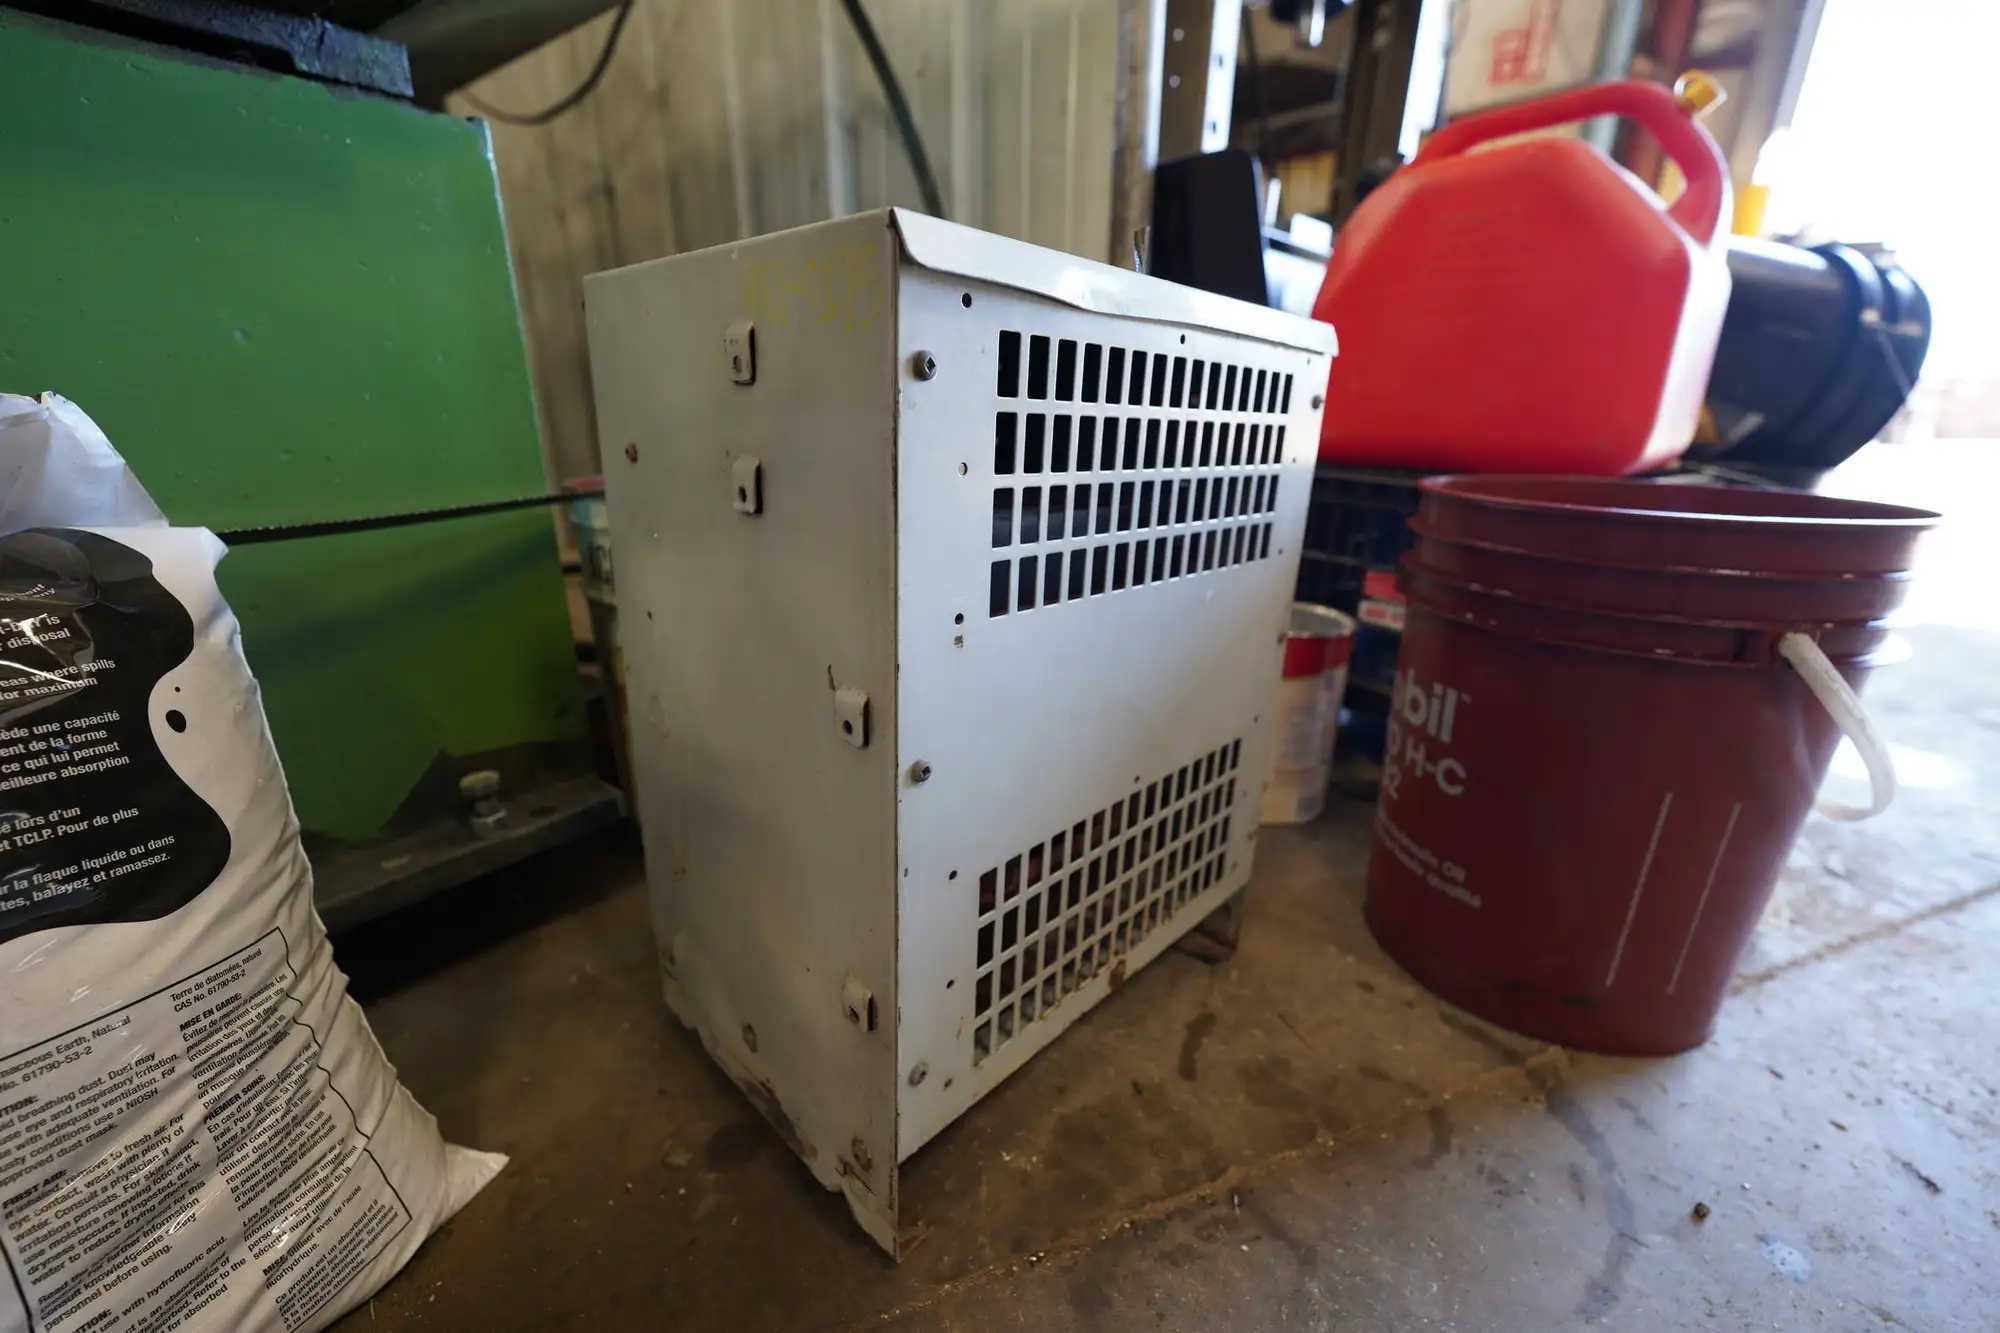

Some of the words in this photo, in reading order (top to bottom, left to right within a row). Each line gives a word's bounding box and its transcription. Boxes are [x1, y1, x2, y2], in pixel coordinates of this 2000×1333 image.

[7, 627, 71, 648] disposal
[46, 616, 60, 626] is
[0, 677, 28, 687] eas
[81, 659, 116, 672] spills
[24, 677, 98, 696] maximum
[0, 727, 29, 741] ède
[32, 722, 61, 735] une
[64, 710, 120, 729] capacité
[0, 744, 26, 758] ent
[28, 739, 48, 750] de
[49, 737, 65, 747] la
[67, 730, 107, 744] forme
[1, 762, 21, 773] ce
[24, 757, 49, 771] qui
[51, 750, 70, 763] lui
[73, 741, 120, 761] permet
[61, 755, 130, 778] absorption
[13, 829, 55, 848] TCLP.
[57, 820, 90, 836] Pour
[93, 814, 110, 827] de
[112, 807, 139, 824] plus
[15, 815, 45, 830] lors
[49, 806, 81, 822] d'un
[0, 896, 30, 912] tes,
[32, 877, 90, 901] balayez
[93, 871, 107, 883] et
[109, 853, 171, 878] ramassez.
[14, 879, 29, 891] la
[32, 863, 79, 886] flaque
[81, 850, 127, 872] liquide
[129, 845, 145, 857] ou
[147, 835, 175, 850] dans
[170, 988, 193, 1002] Terre
[194, 981, 205, 991] de
[205, 962, 242, 984] diatomées,
[174, 998, 192, 1013] CAS
[193, 993, 207, 1004] No.
[207, 969, 247, 997] 61790-53-2
[179, 1014, 201, 1032] MISE
[202, 1007, 215, 1019] EN
[215, 992, 242, 1012] GARDE:
[0, 1050, 53, 1078] maceous
[55, 1035, 90, 1055] Earth,
[91, 1016, 131, 1039] Natural
[182, 1024, 208, 1042] Évitez
[22, 1046, 93, 1083] 61790-53-2
[18, 1091, 76, 1122] breathing
[78, 1077, 106, 1096] dust.
[108, 1063, 132, 1080] Dust
[134, 1052, 156, 1068] may
[25, 1118, 47, 1133] eye
[50, 1104, 73, 1121] and
[75, 1076, 133, 1109] respiratory
[46, 1106, 100, 1137] adequate
[102, 1077, 160, 1108] ventilation.
[161, 1065, 176, 1079] For
[30, 1123, 91, 1158] conditions
[93, 1112, 114, 1126] use
[116, 1107, 124, 1116] a
[126, 1087, 158, 1110] NIOSH
[124, 1133, 151, 1154] fresh
[169, 1113, 184, 1127] For
[207, 1123, 220, 1134] En
[220, 1112, 236, 1125] cas
[56, 1139, 83, 1157] dust
[117, 1154, 140, 1171] with
[141, 1134, 172, 1157] plenty
[174, 1126, 185, 1137] of
[219, 1152, 251, 1177] utiliser
[54, 1191, 99, 1220] Consult
[110, 1156, 159, 1189] physician
[177, 1160, 201, 1181] drink
[73, 1193, 121, 1225] persists.
[123, 1179, 141, 1194] For
[103, 1187, 151, 1219] renewing
[31, 1261, 66, 1286] water
[68, 1253, 81, 1264] to
[83, 1227, 122, 1254] reduce
[123, 1206, 156, 1230] drying
[44, 1287, 102, 1332] personnel
[103, 1264, 140, 1292] before
[141, 1243, 174, 1269] using.
[100, 1315, 120, 1332] use
[121, 1297, 146, 1316] with
[146, 1253, 204, 1299] hydrofluoric
[206, 1236, 228, 1256] acid.
[193, 1279, 219, 1300] Refer
[220, 1270, 230, 1281] to
[230, 1257, 246, 1272] the
[184, 1283, 228, 1321] absorbed
